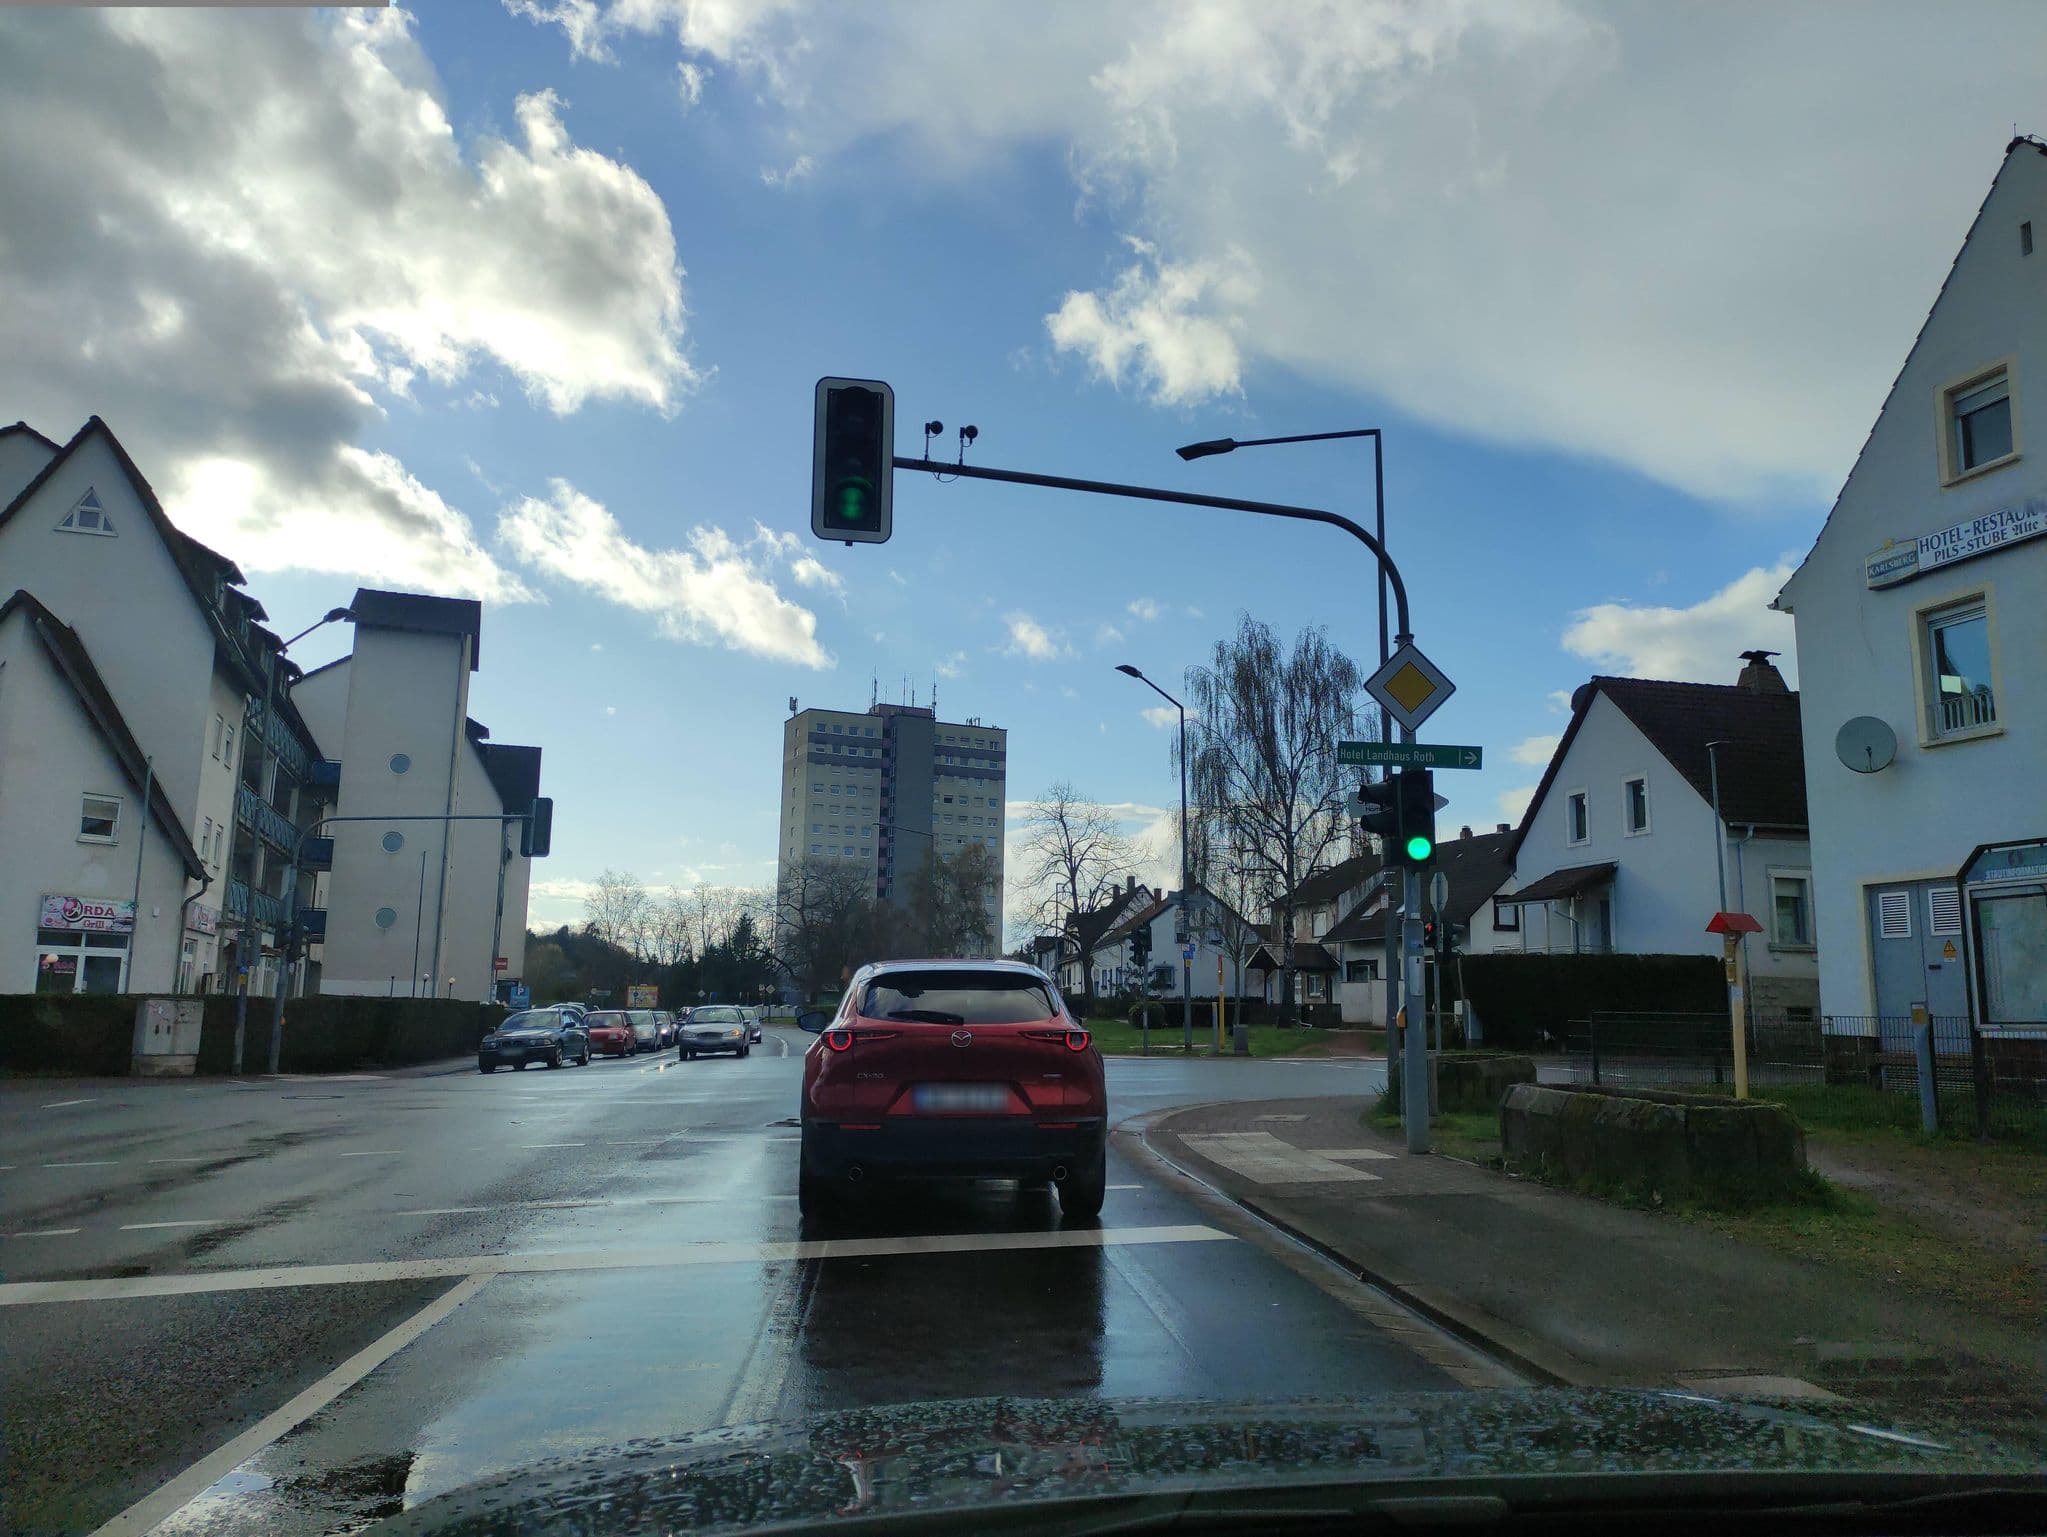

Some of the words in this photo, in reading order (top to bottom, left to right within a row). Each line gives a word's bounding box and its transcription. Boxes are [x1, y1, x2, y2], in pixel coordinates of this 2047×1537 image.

[1934, 528, 2008, 563] PILS-STUBE
[1340, 749, 1364, 760] Hotel
[1366, 750, 1411, 762] Landhaus
[1413, 751, 1435, 763] Roth
[83, 920, 105, 929] Grill
[517, 987, 525, 996] P
